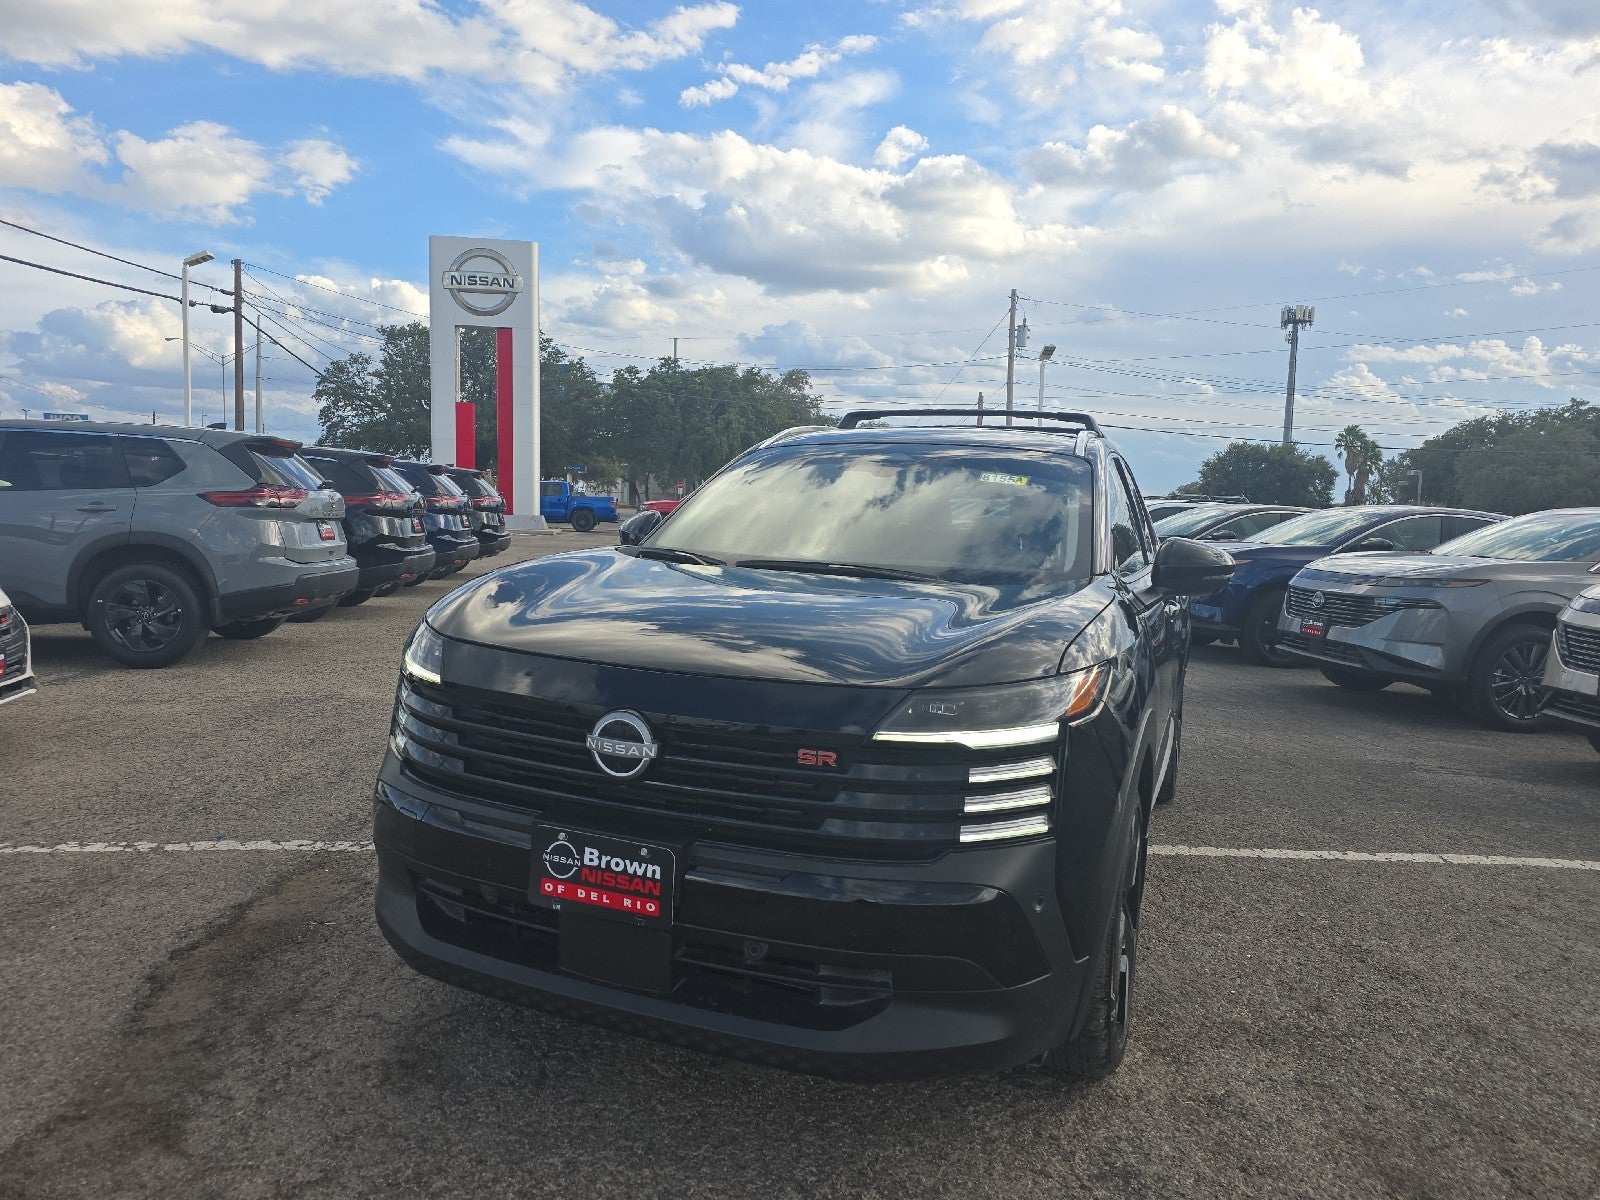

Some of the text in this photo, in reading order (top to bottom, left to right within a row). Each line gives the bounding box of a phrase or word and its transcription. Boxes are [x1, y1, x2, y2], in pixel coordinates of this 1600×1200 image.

[450, 274, 514, 288] NISSAN
[587, 736, 656, 757] NISSAN
[797, 748, 837, 766] SR
[542, 852, 580, 866] NISSAN
[583, 846, 661, 879] Brown
[581, 867, 661, 895] NISSAN
[544, 883, 656, 911] OF DEL RIO
